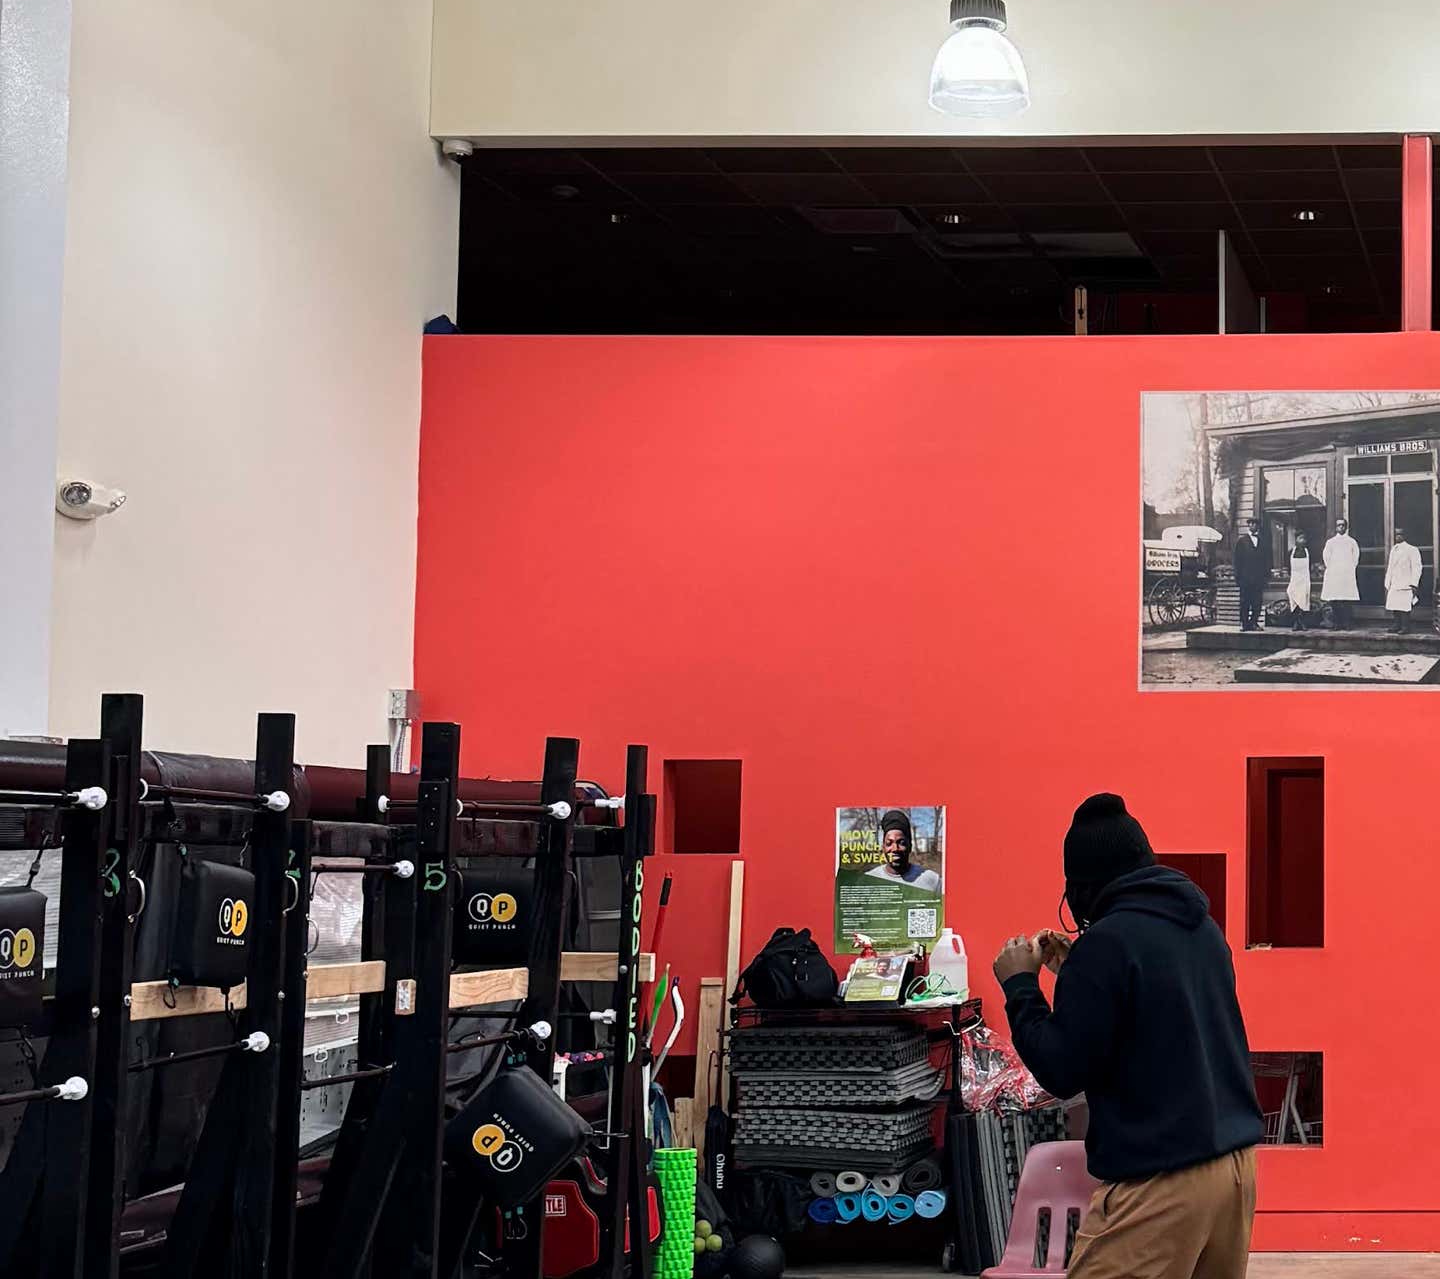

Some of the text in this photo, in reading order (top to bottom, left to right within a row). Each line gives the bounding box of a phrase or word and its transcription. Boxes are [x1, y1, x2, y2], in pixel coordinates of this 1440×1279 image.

[1358, 442, 1397, 455] WILLIAMS
[841, 830, 876, 840] MOVE
[841, 841, 883, 852] PUNCH
[841, 853, 894, 863] & SWEAT
[424, 860, 447, 891] 5
[627, 860, 644, 1063] BODIED
[545, 1198, 564, 1214] TLE
